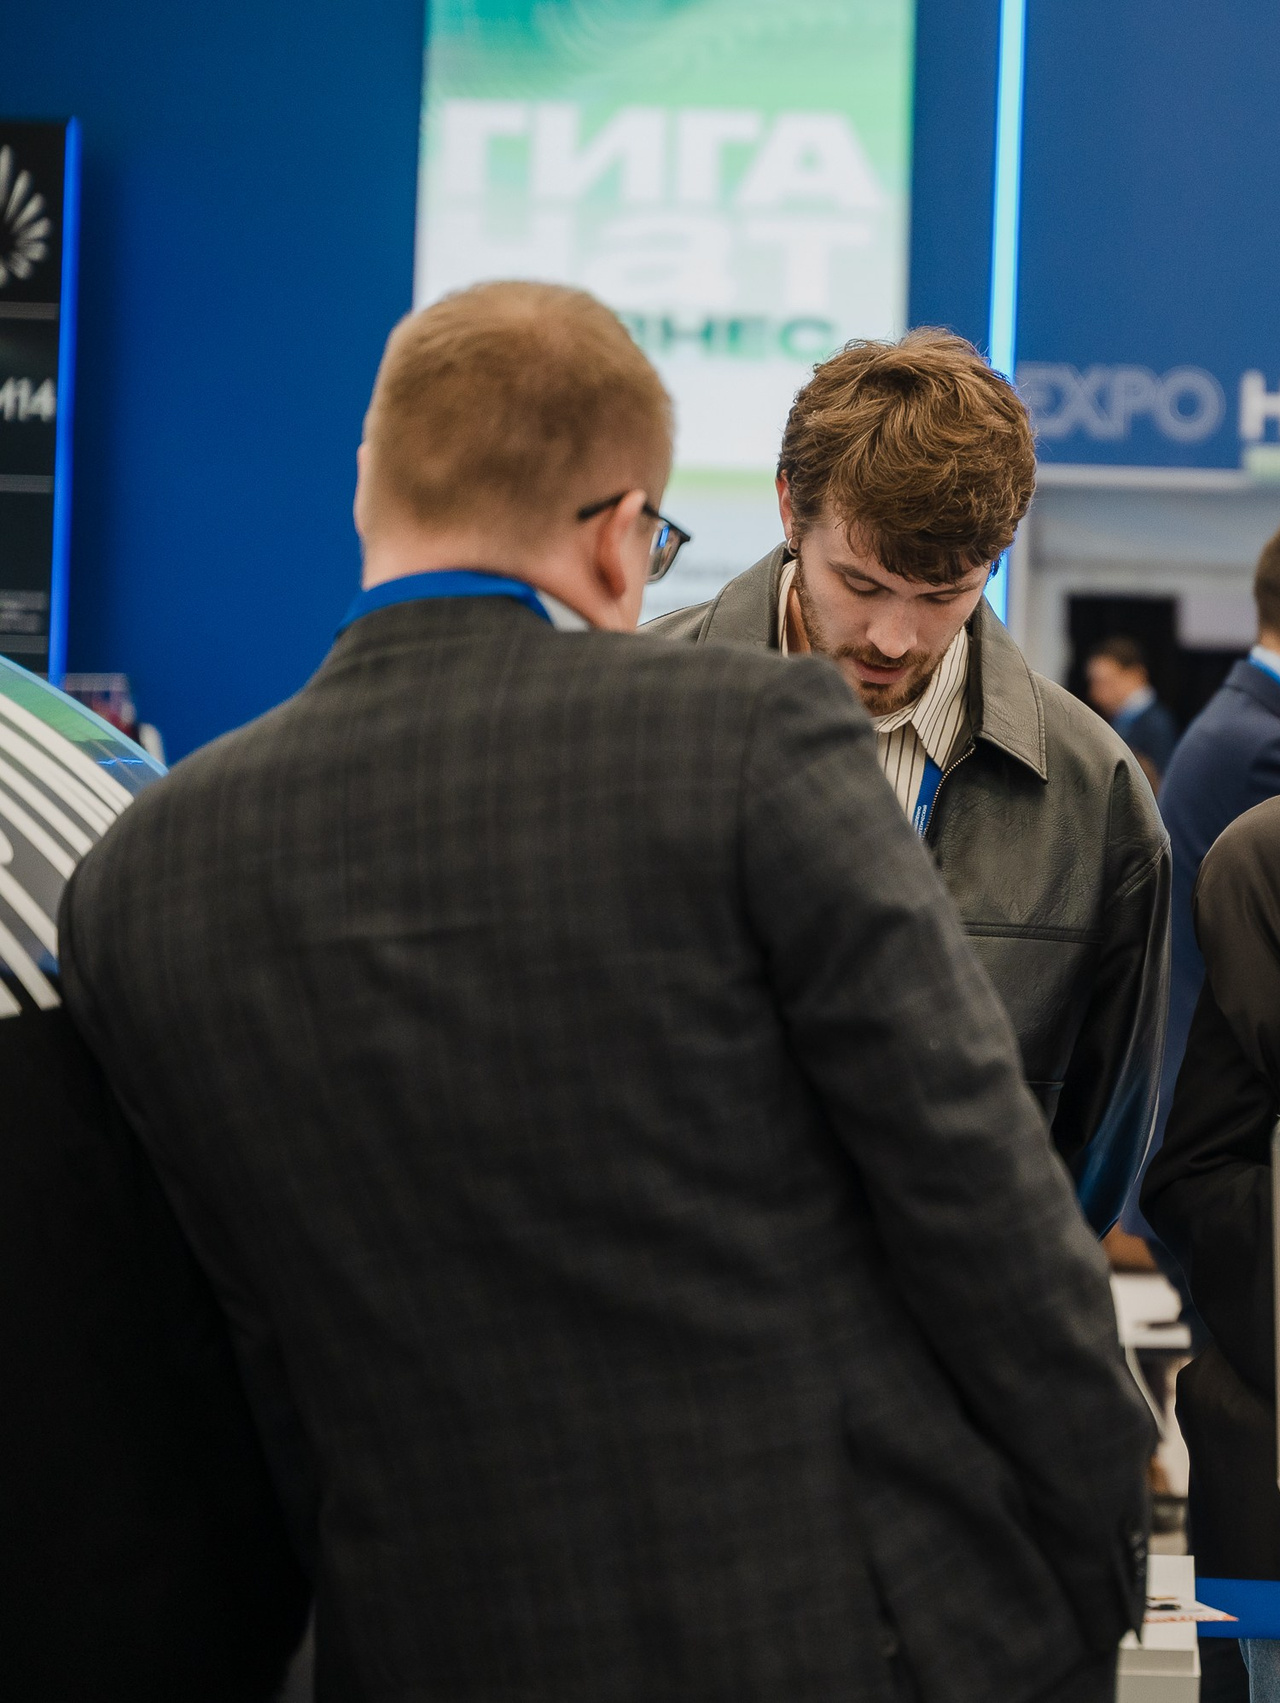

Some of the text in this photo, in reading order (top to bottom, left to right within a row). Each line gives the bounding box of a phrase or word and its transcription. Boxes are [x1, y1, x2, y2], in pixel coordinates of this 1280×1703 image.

[440, 98, 888, 209] ГИГА
[622, 312, 838, 360] НЕС
[1016, 362, 1226, 443] EXPO
